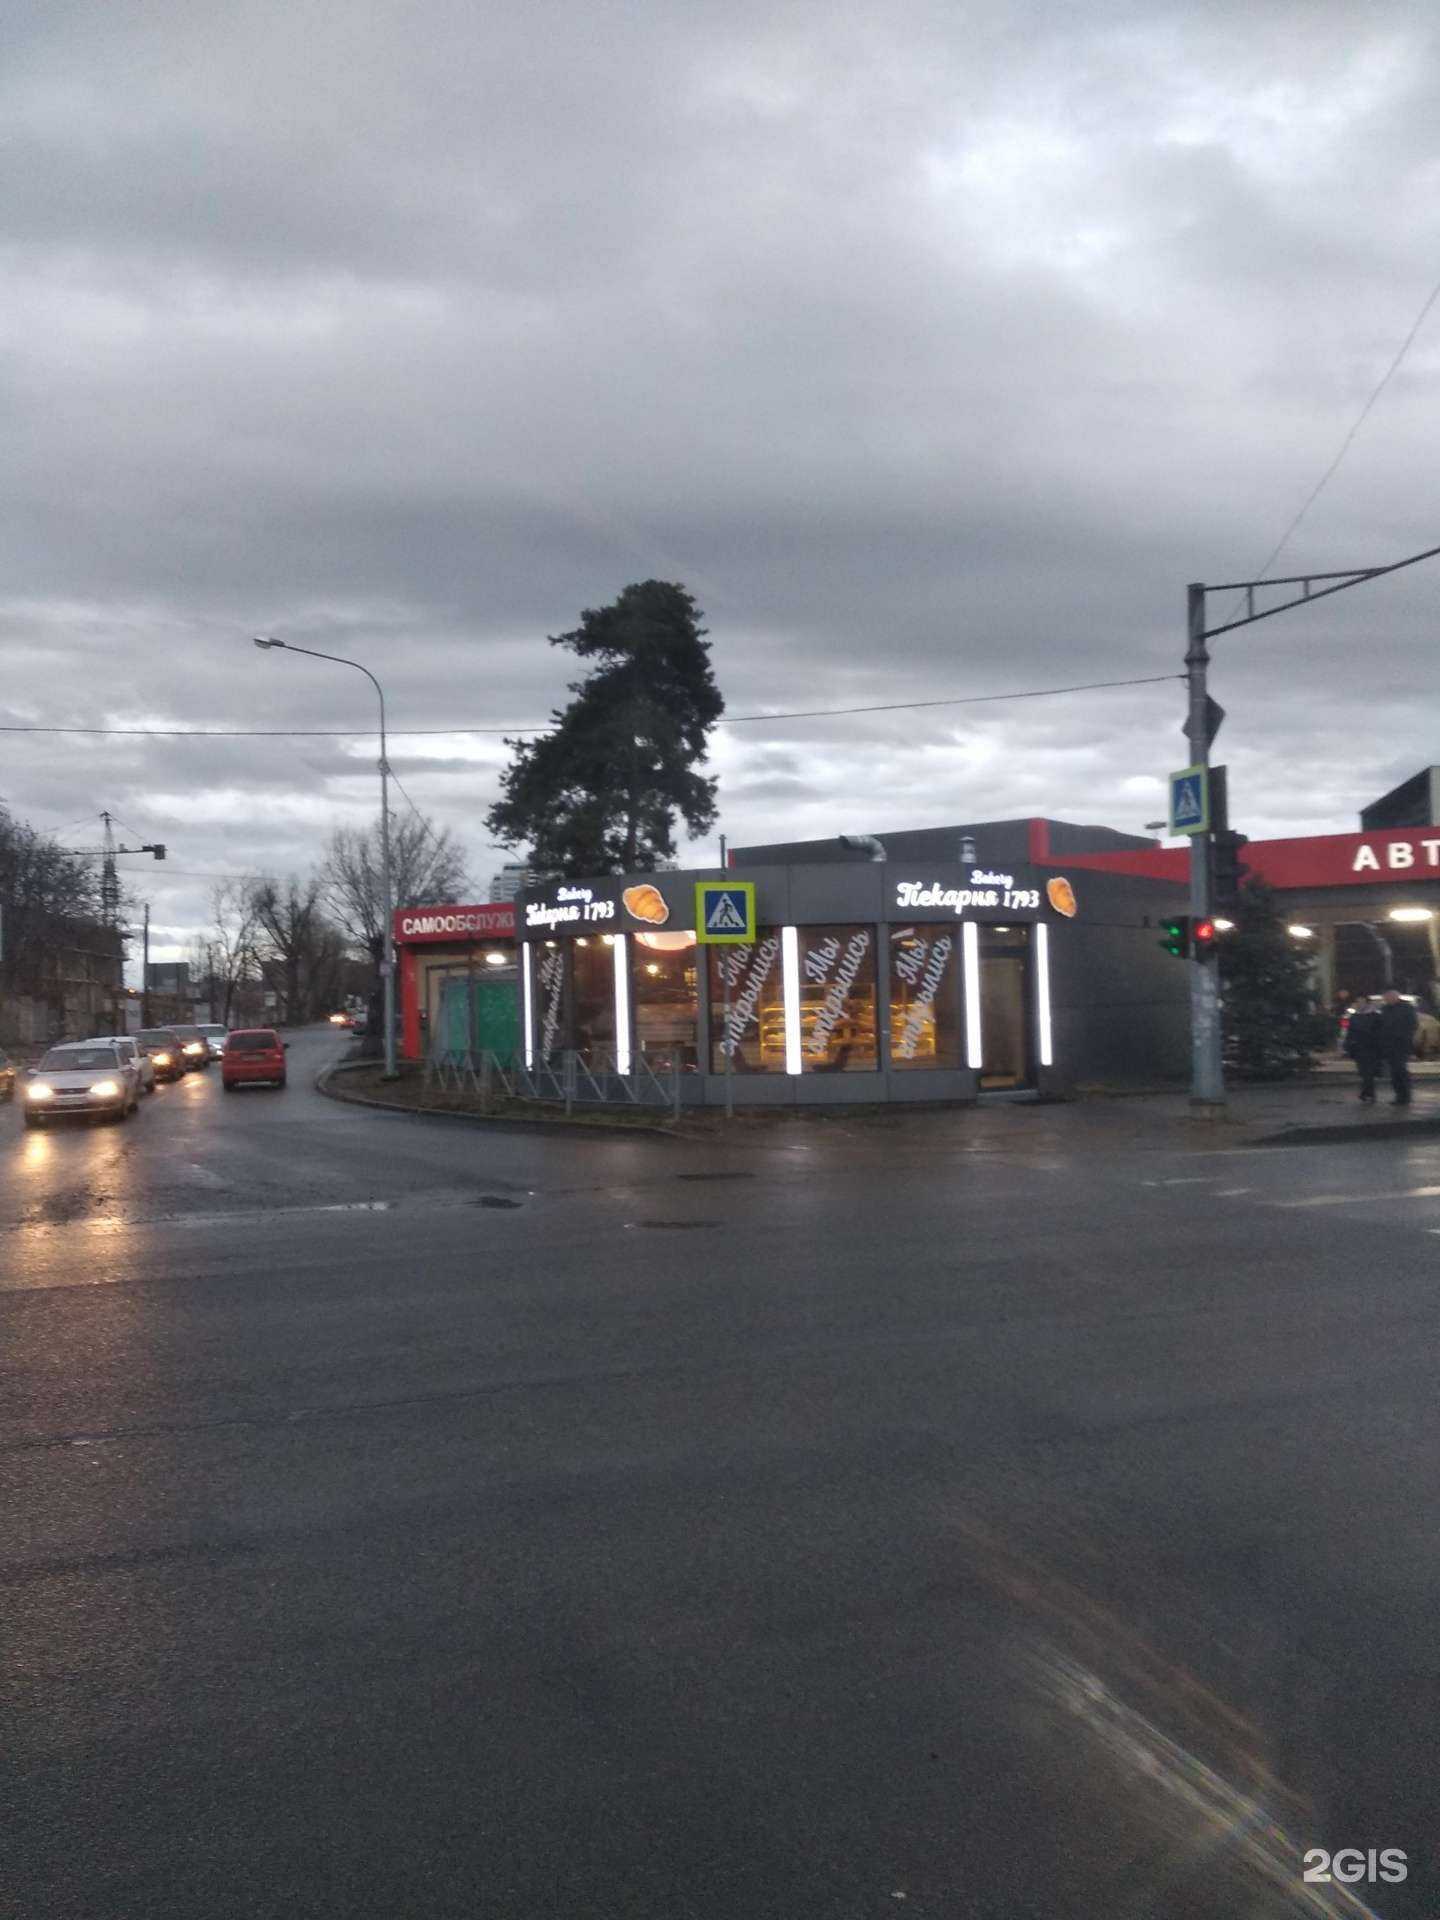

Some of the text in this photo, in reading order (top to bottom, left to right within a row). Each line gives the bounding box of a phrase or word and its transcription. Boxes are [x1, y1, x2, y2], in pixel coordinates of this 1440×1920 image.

[584, 900, 615, 922] 1793
[896, 880, 1040, 915] Пекарня 1793
[805, 936, 841, 984] Мы
